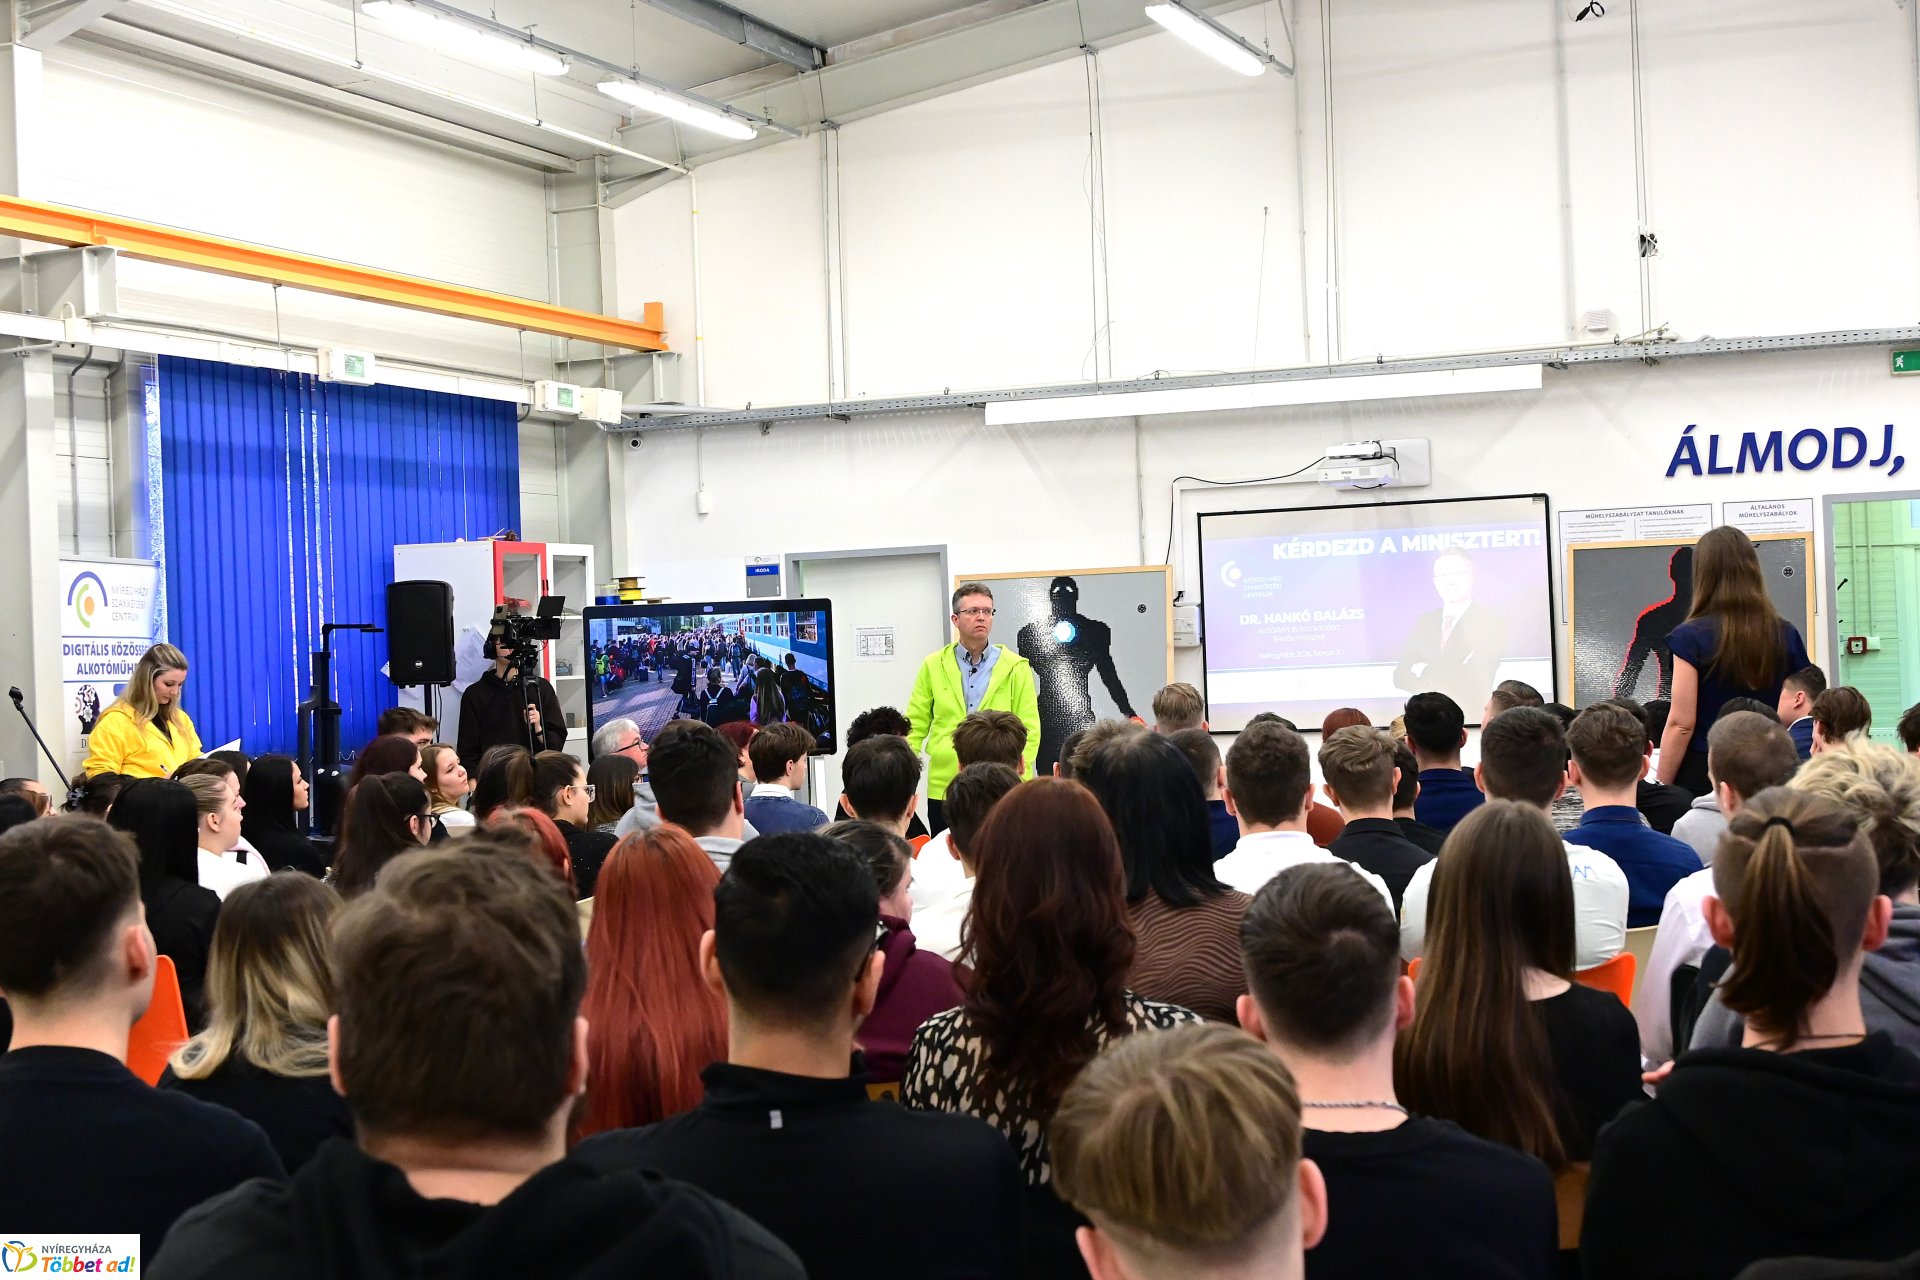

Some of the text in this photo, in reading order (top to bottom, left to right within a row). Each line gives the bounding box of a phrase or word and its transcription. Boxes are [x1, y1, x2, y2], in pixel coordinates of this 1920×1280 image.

[1665, 424, 1905, 477] ÁLMODJ,
[1585, 511, 1644, 519] MŰHELYSZABÁLYZAT
[1645, 509, 1684, 517] TANULÓKNAK
[1273, 529, 1541, 560] KÉRDEZD A MINISZTERT!
[1240, 606, 1365, 625] DR. HANKÓ BALÁZS
[63, 641, 149, 656] DIGITÁLIS KÖZÖSSÉ
[76, 660, 137, 675] ALKOTÓMŰH
